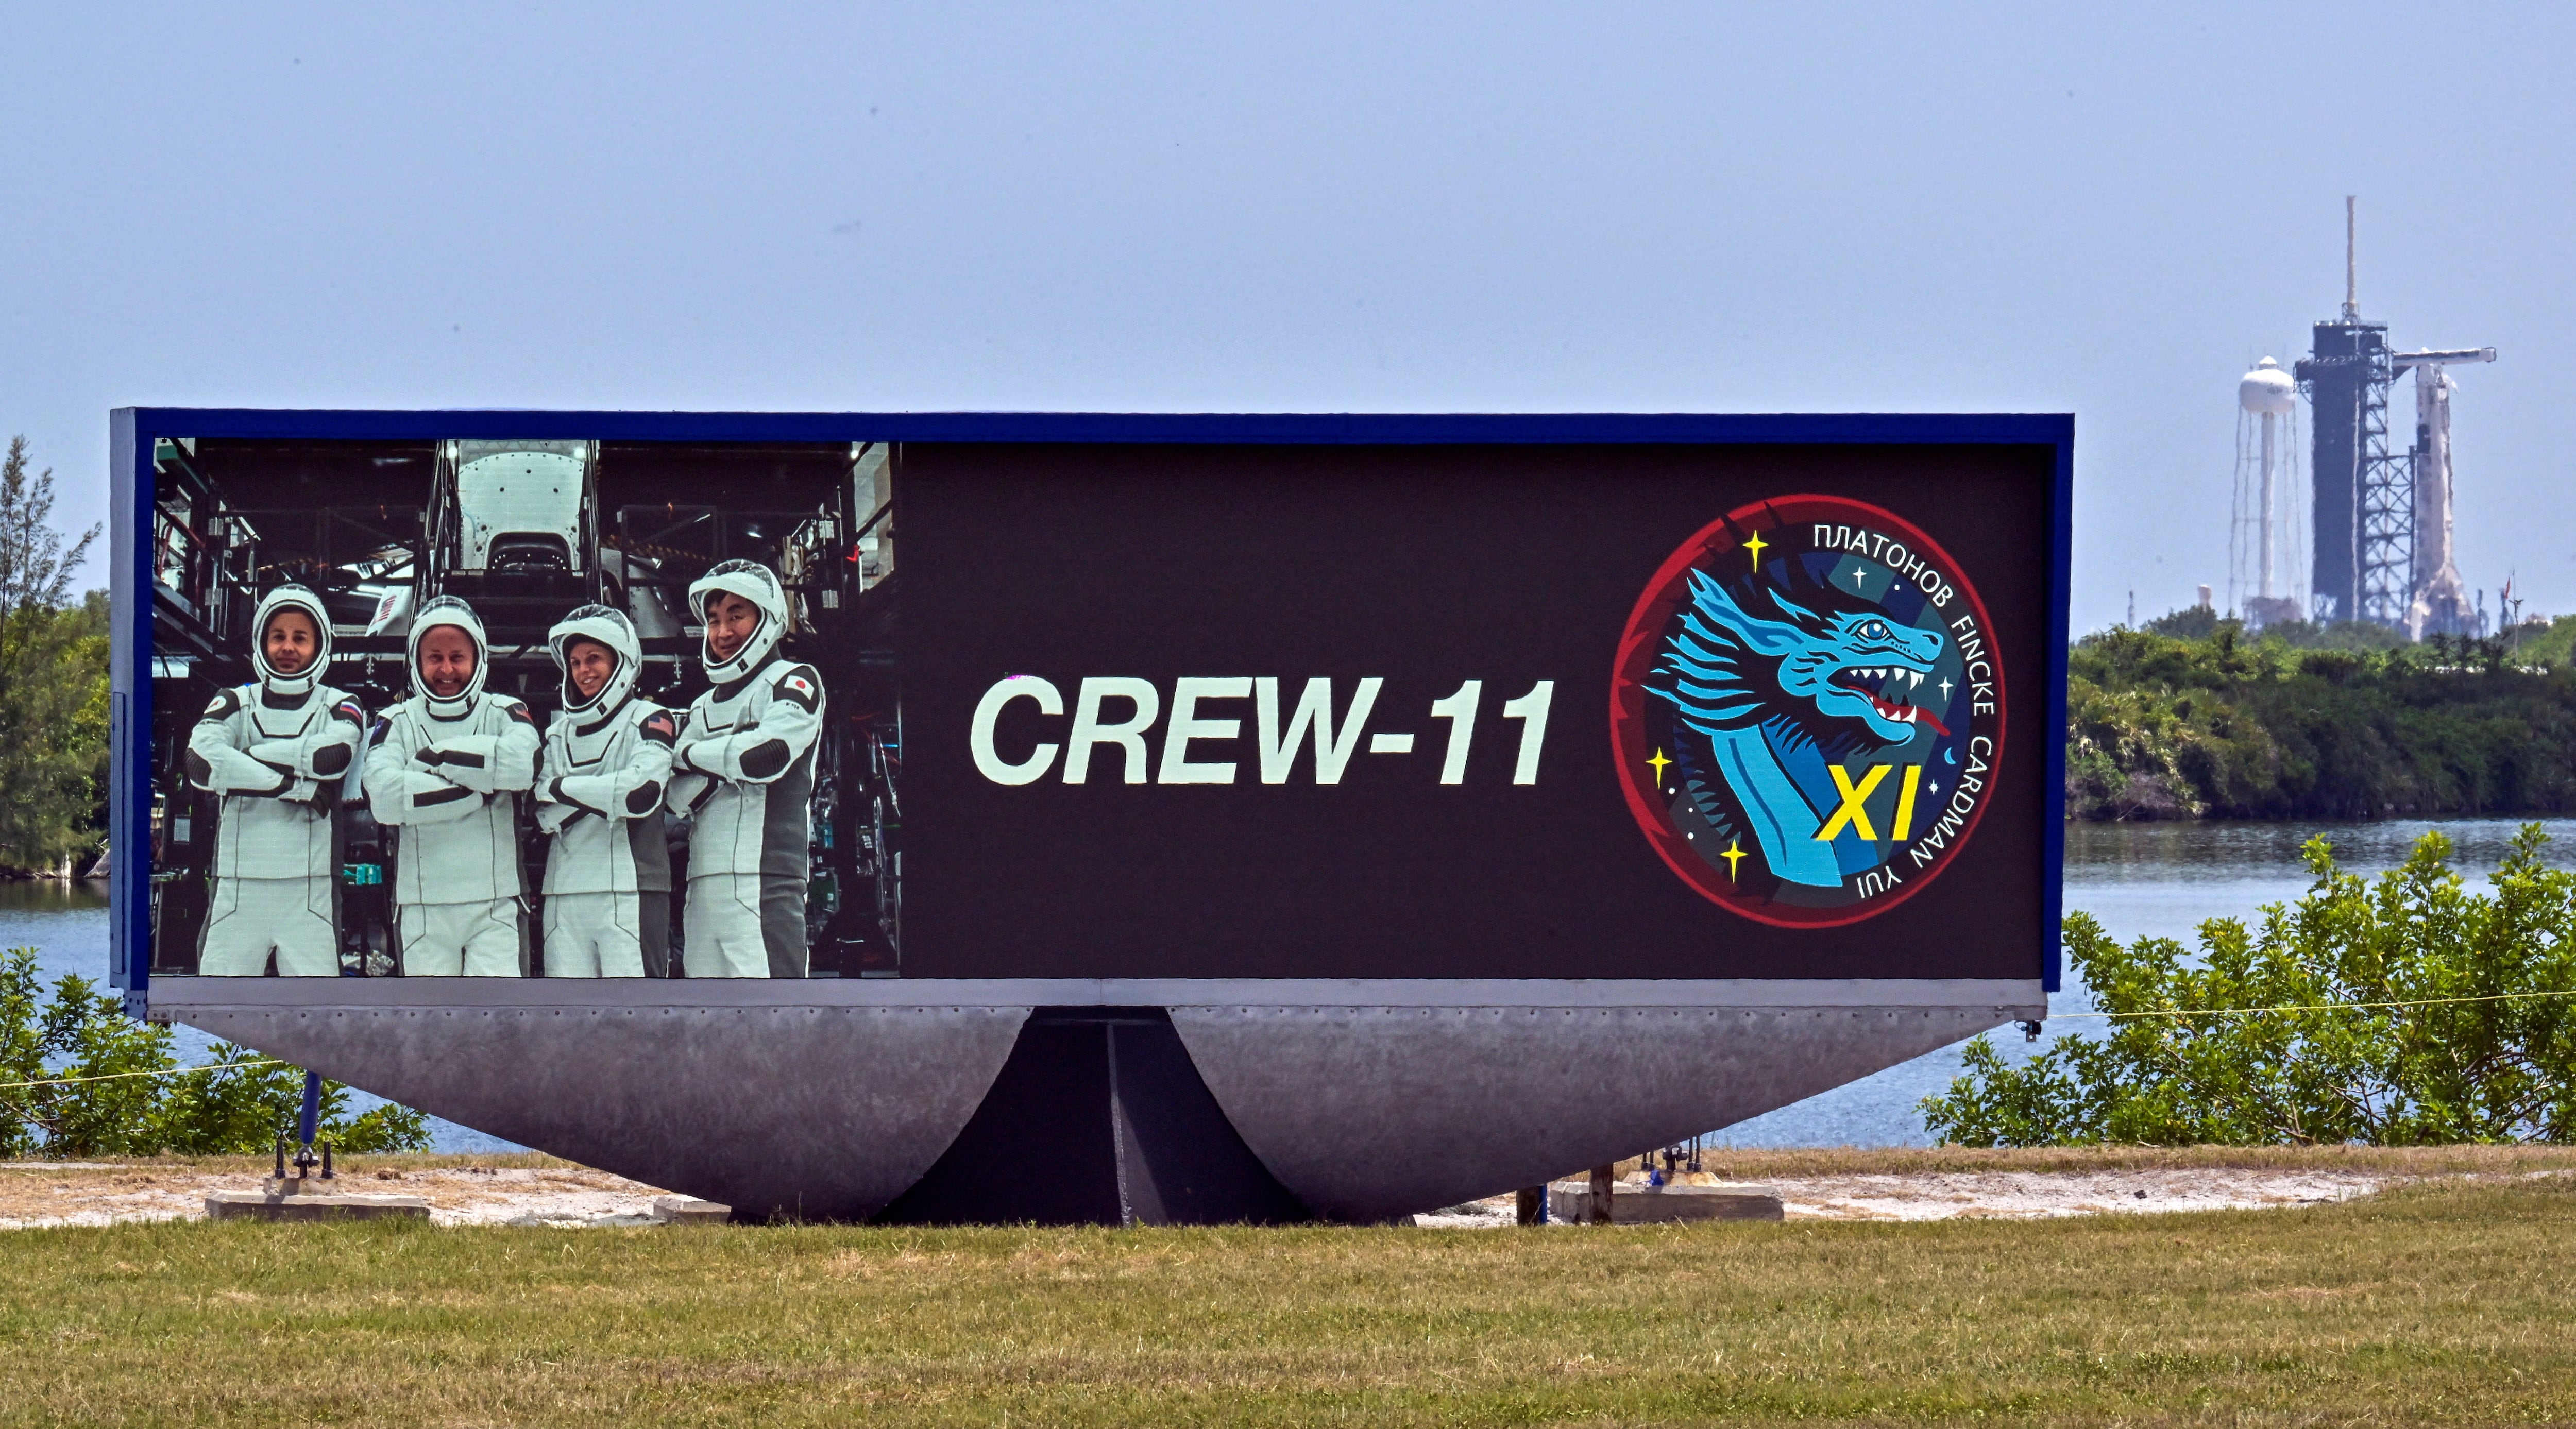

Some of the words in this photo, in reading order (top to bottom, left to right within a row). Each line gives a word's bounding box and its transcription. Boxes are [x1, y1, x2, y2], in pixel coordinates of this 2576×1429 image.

[1814, 524, 1953, 607] ПЛАТОНОВ
[1951, 615, 1994, 716] FINCKE
[970, 675, 1554, 785] CREW-11
[1816, 763, 1922, 841] XI
[1910, 736, 1992, 869] CARDMAN
[1857, 865, 1902, 899] YUI
